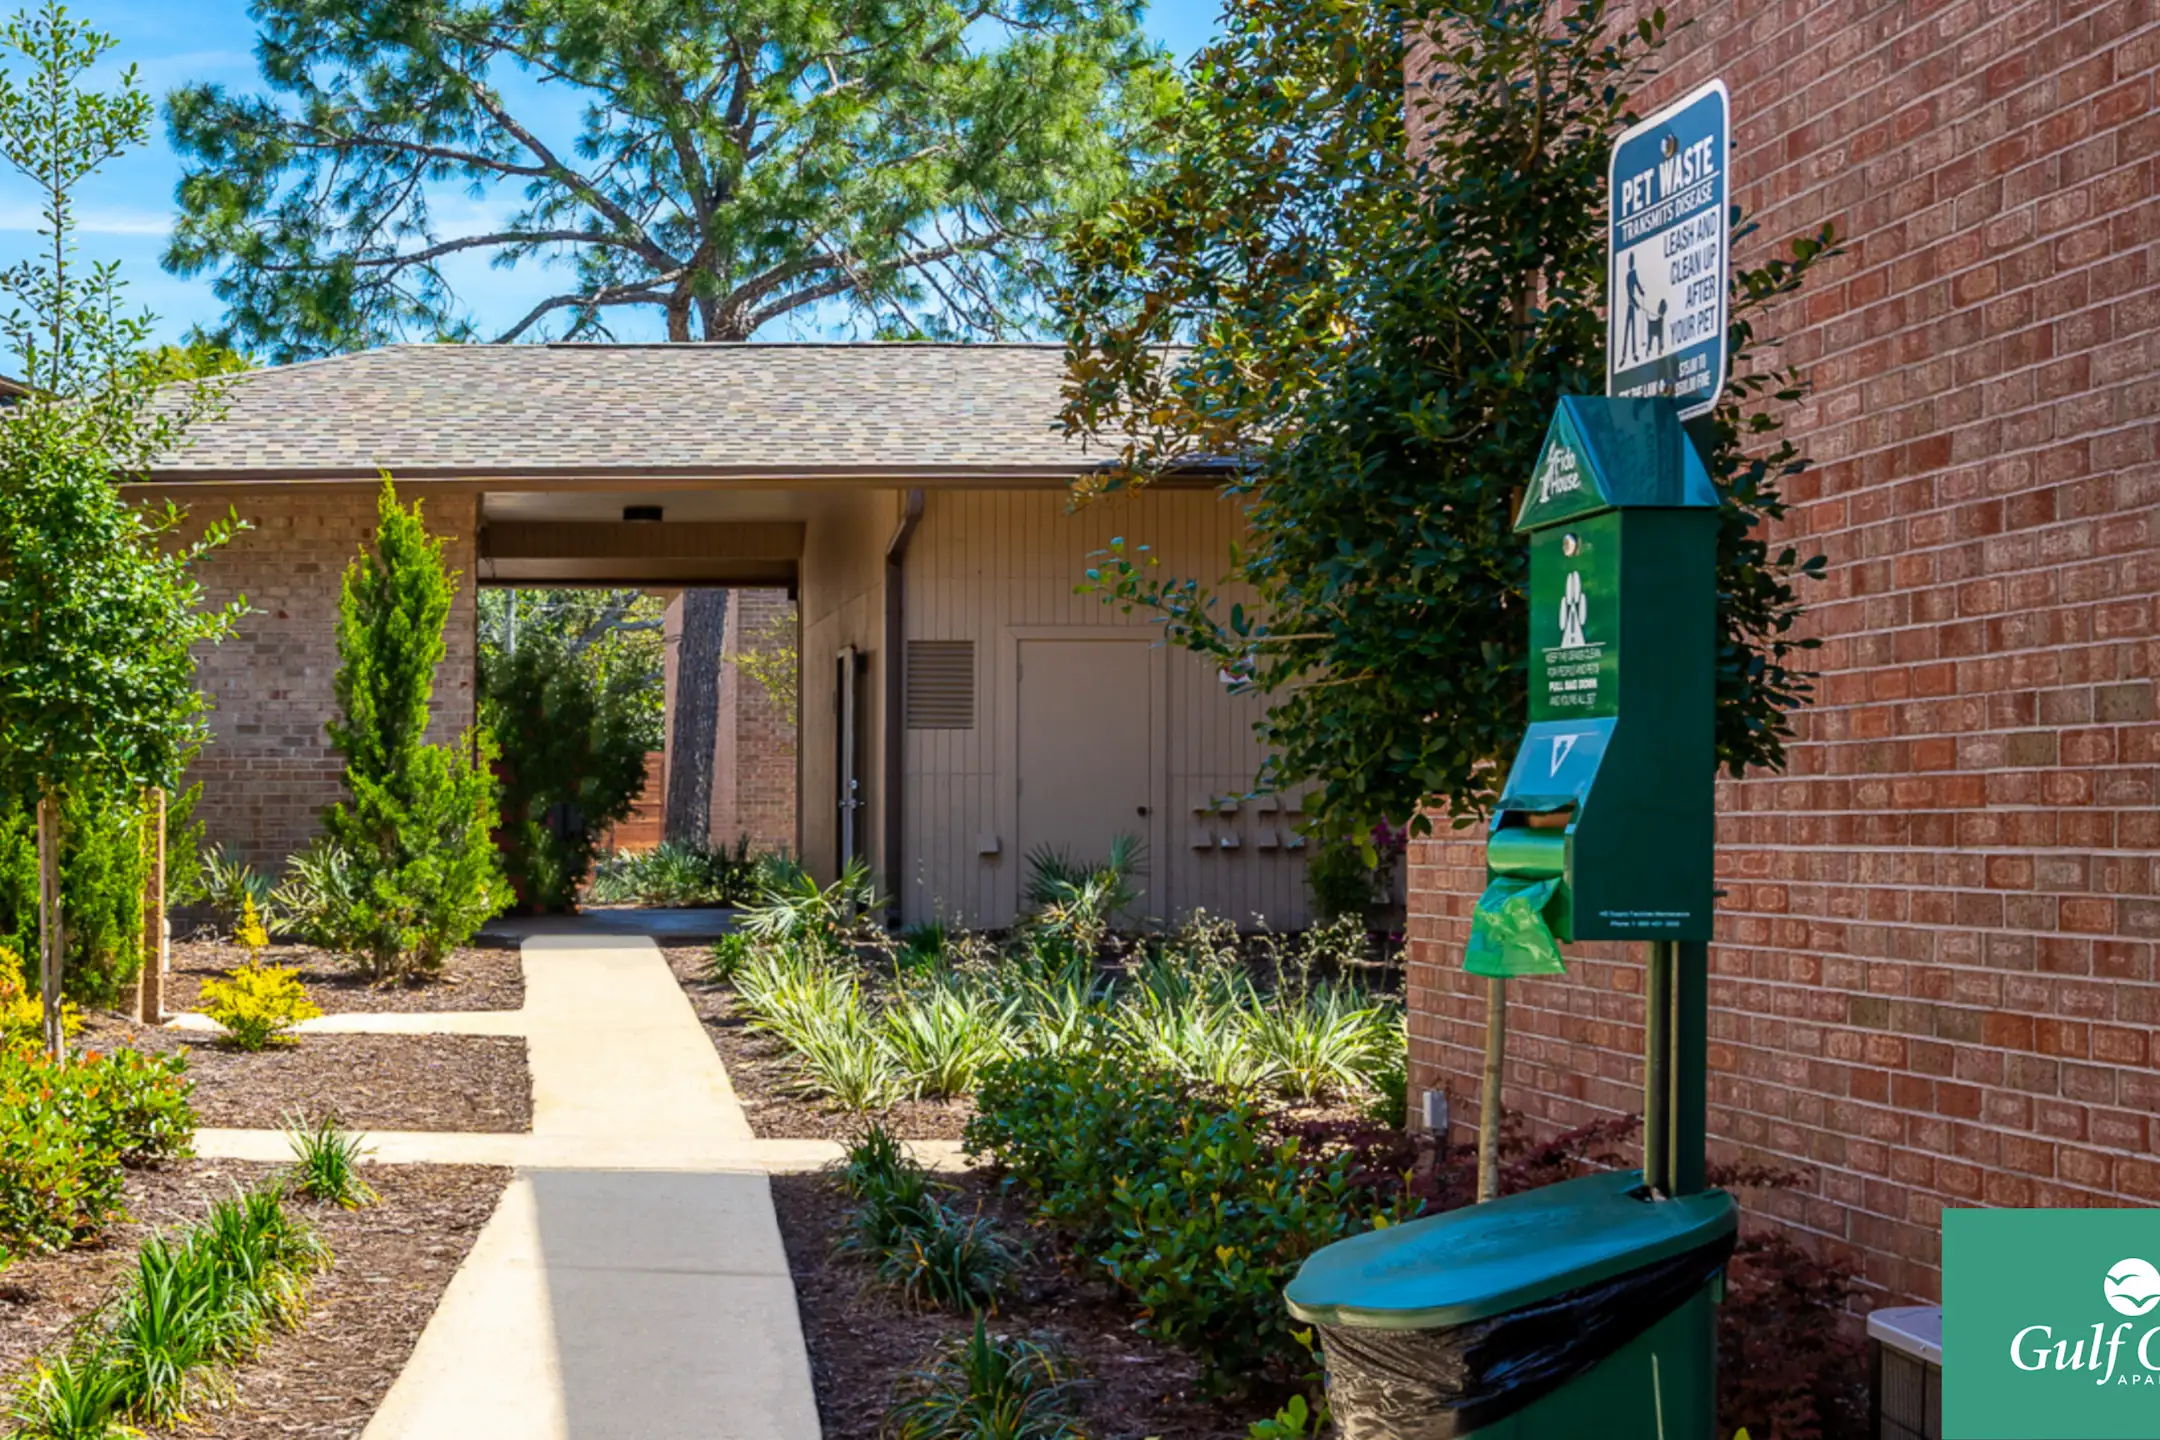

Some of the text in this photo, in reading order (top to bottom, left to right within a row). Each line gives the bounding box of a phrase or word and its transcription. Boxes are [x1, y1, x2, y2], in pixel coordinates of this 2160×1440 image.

[1622, 134, 1714, 217] PET WASTE
[1622, 180, 1714, 242] TRANSMITS DISEASE
[1663, 211, 1717, 258] LEASH AND
[1670, 242, 1716, 285] CLEAN UP
[1685, 274, 1716, 310] AFTER
[1669, 305, 1716, 346] YOUR PET
